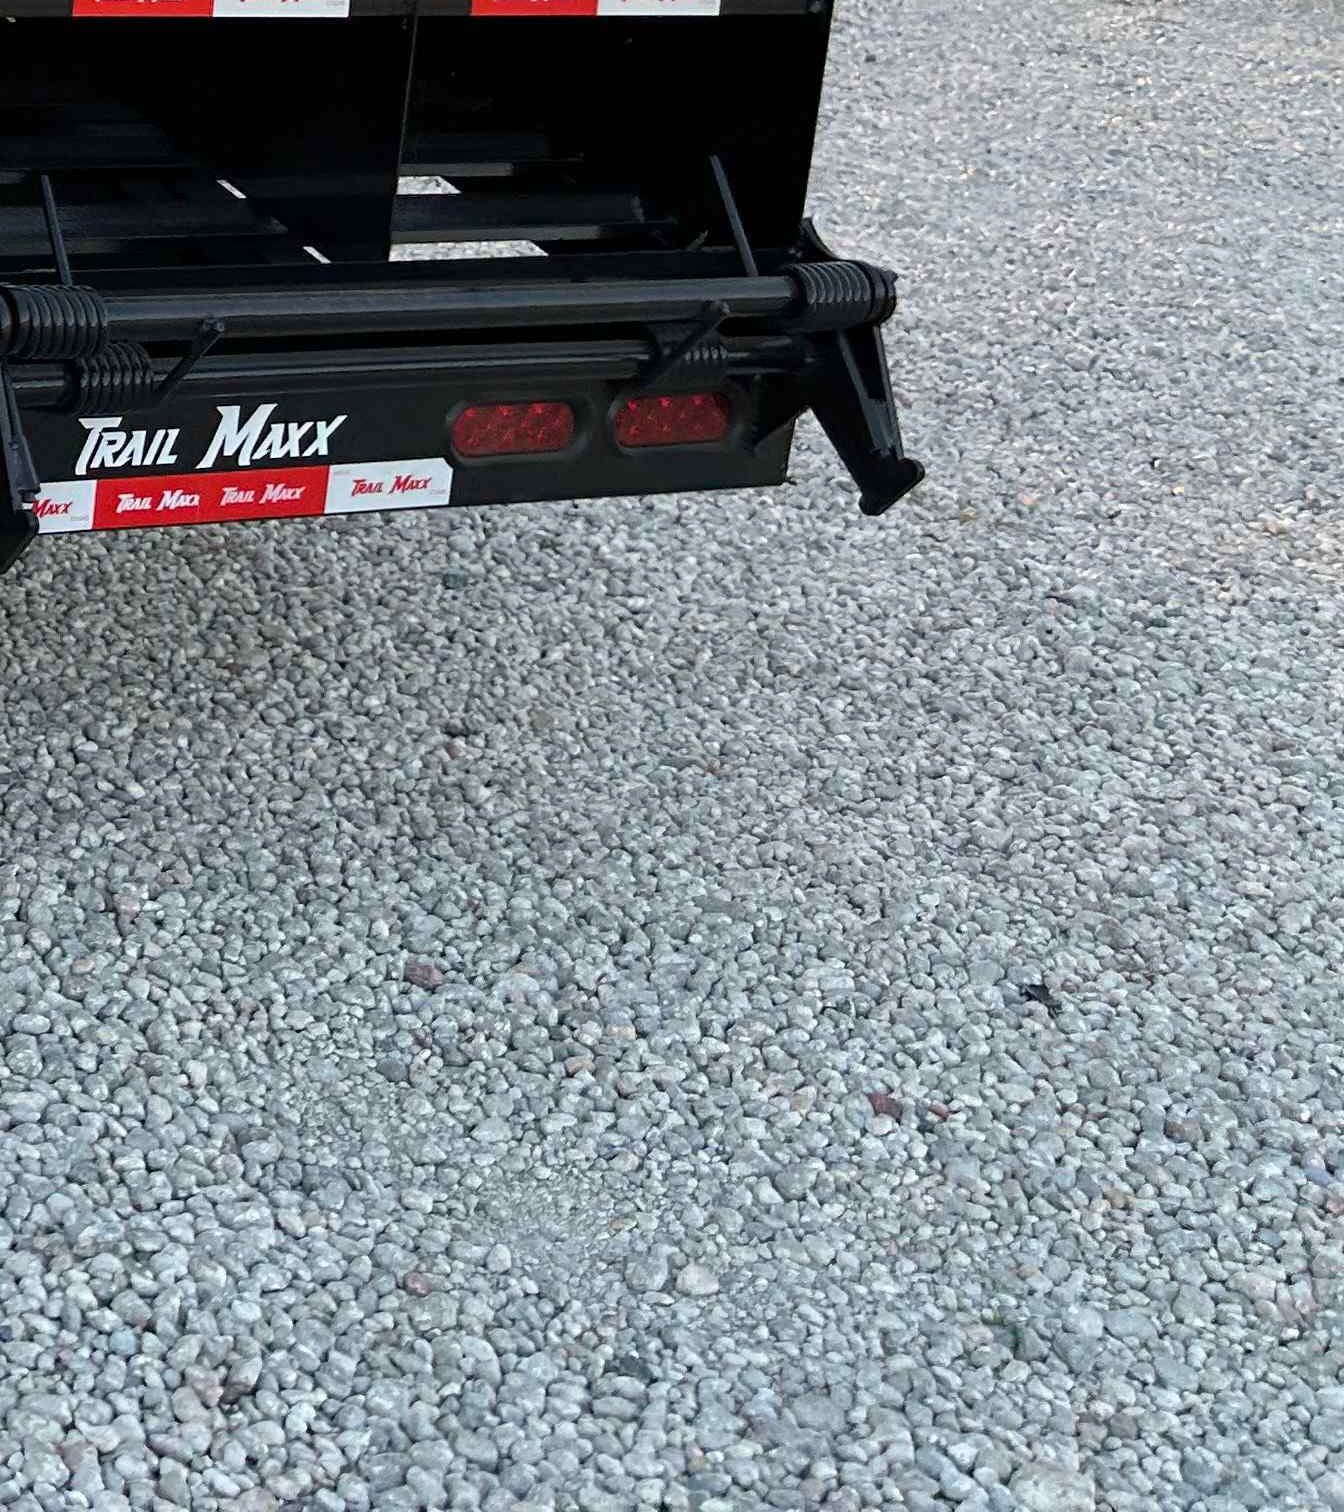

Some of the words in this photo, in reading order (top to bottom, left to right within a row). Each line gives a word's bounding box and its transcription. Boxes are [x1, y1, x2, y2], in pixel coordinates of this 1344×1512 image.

[74, 416, 181, 476] TRAIL
[196, 403, 348, 470] MAXX
[220, 486, 255, 506] TRAIL
[259, 483, 307, 504] MAXX
[351, 478, 384, 496] TRAIL
[388, 475, 432, 495] MAXX
[115, 493, 152, 514] TRAIL
